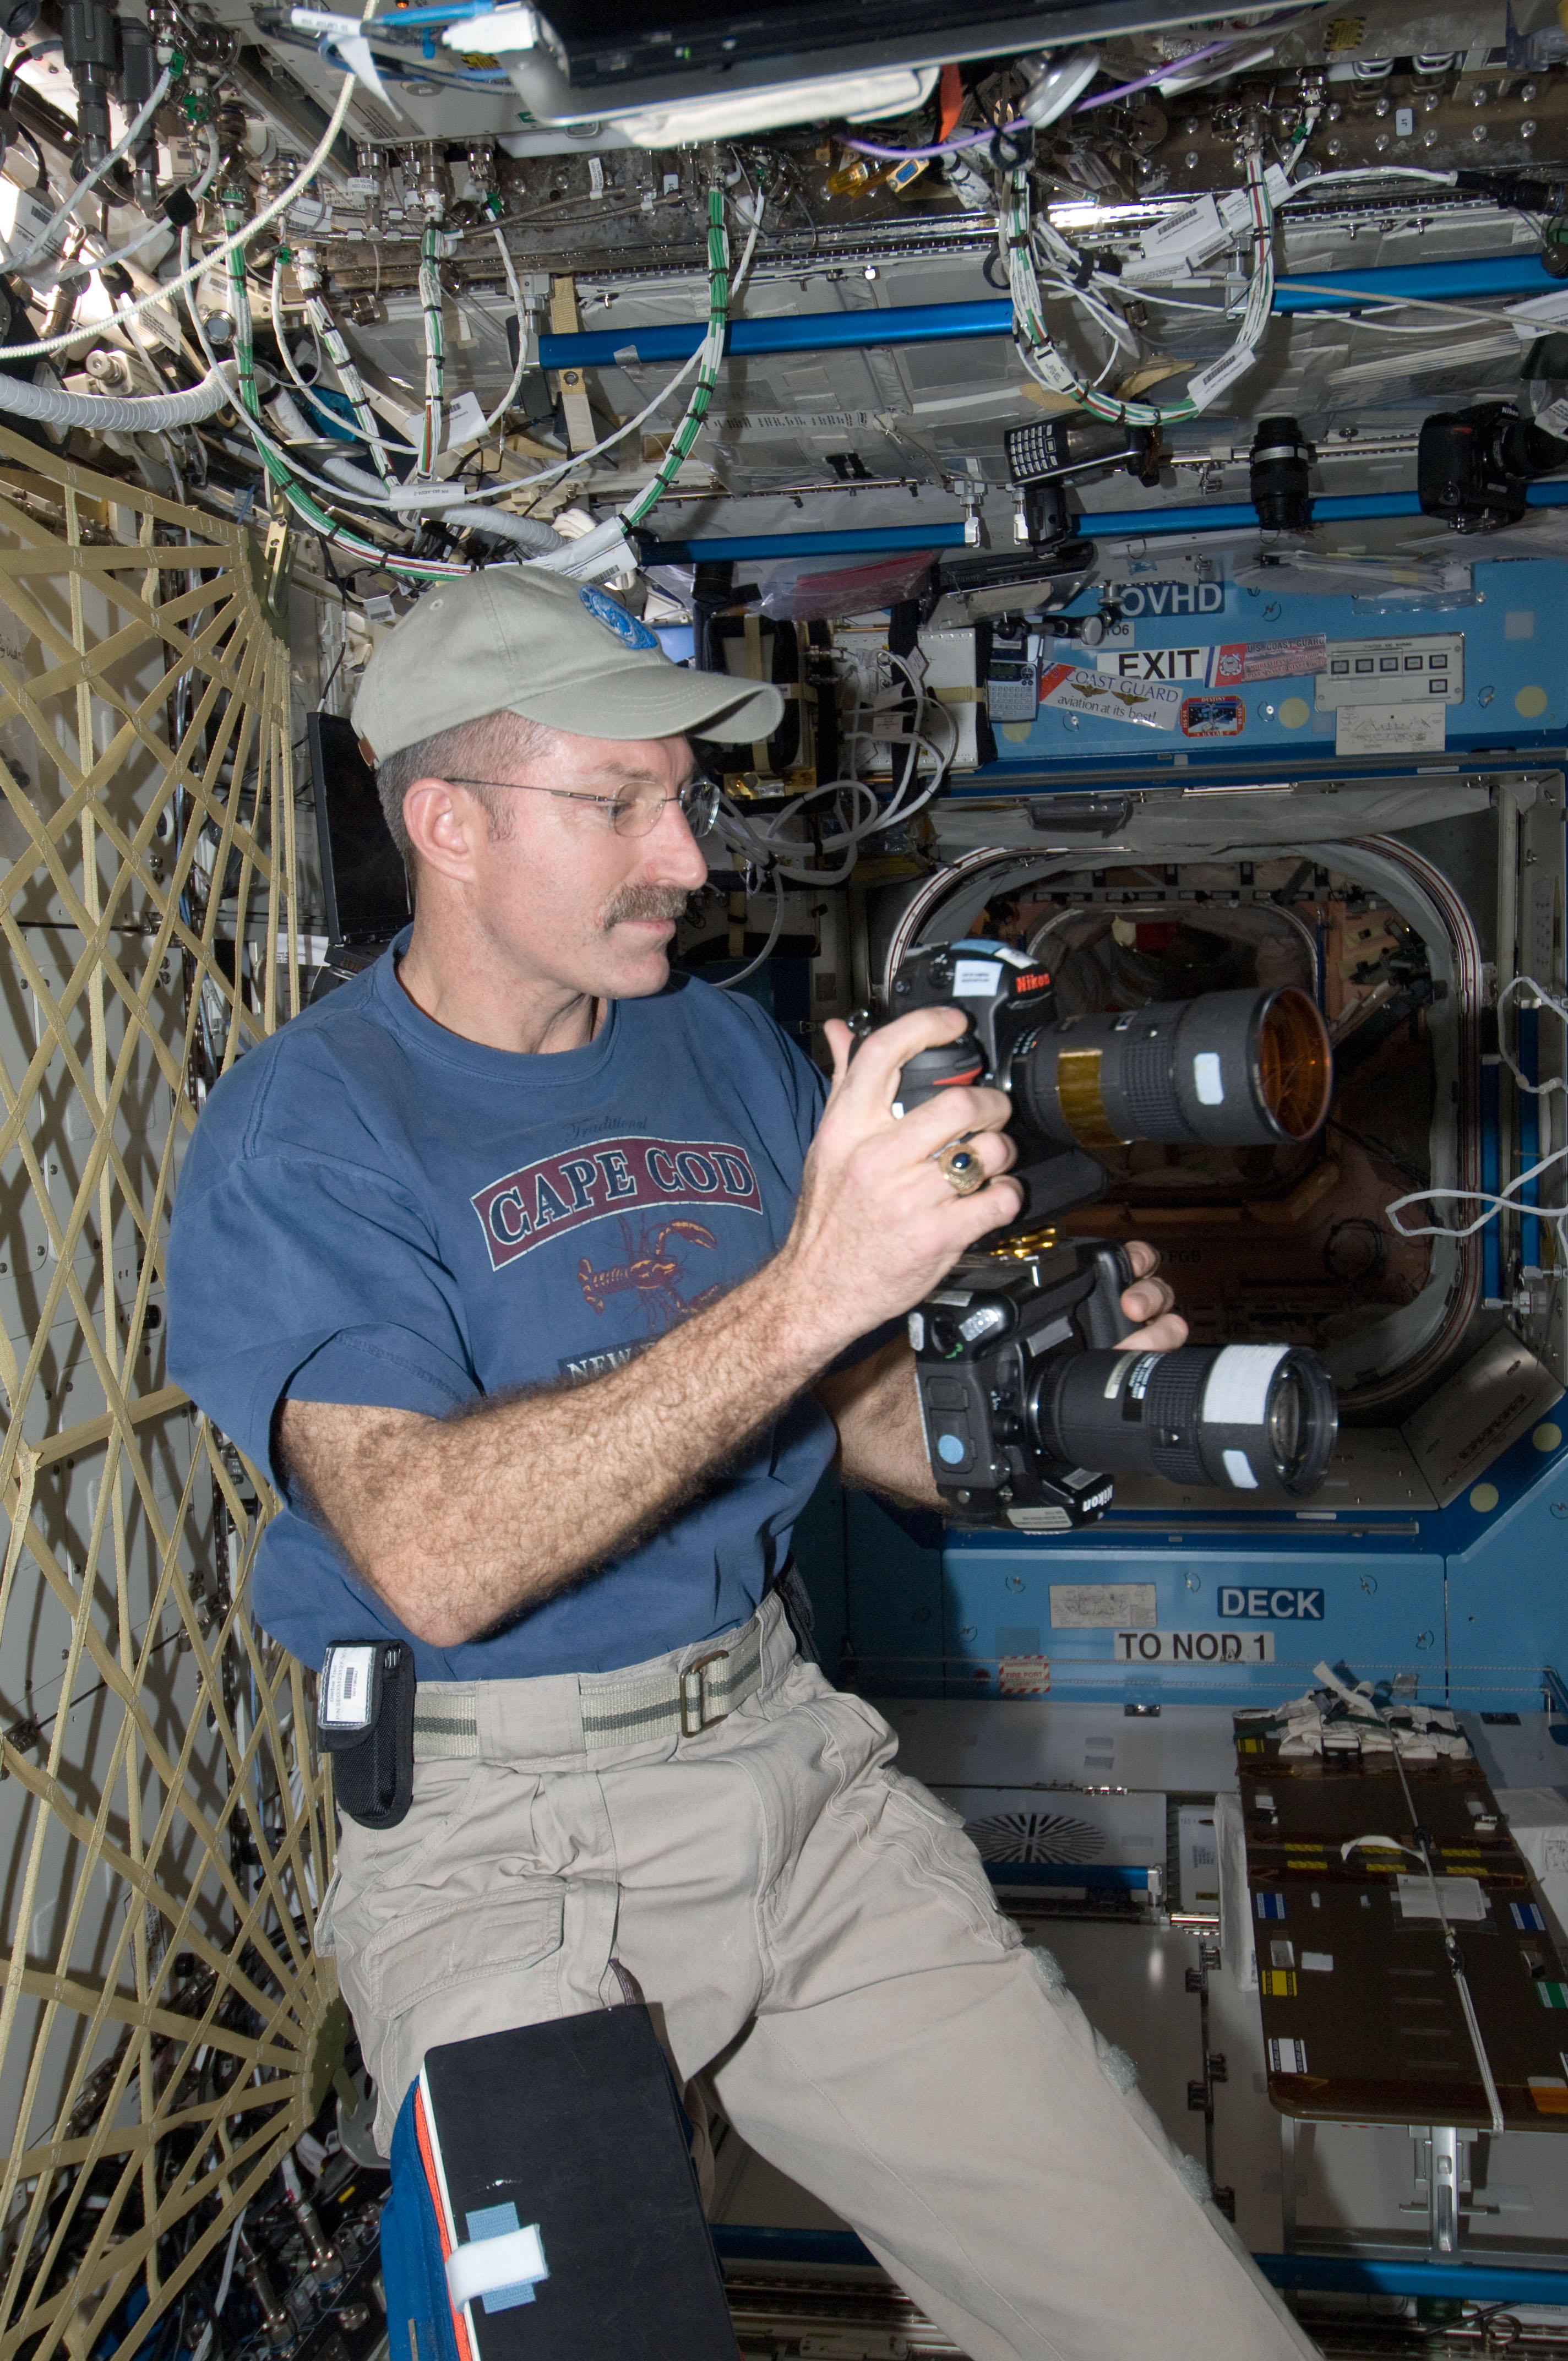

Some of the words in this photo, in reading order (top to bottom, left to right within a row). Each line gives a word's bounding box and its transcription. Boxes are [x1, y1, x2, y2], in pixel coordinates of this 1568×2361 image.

[1401, 118, 1408, 127] J1
[1120, 583, 1223, 615] OVHD
[1267, 641, 1294, 651] COAST
[1297, 637, 1325, 647] GUARD
[1118, 650, 1201, 682] EXIT
[1065, 669, 1116, 689] COAST
[1120, 681, 1178, 703] GUARD
[1058, 695, 1098, 712] aviation
[1101, 705, 1110, 714] at
[1113, 705, 1125, 716] its
[1129, 708, 1156, 723] best!
[1015, 972, 1052, 993] Nikon
[564, 1116, 649, 1141] Traditional
[488, 1149, 637, 1245] CAPE
[645, 1146, 755, 1197] COD
[1082, 1484, 1114, 1512] Nikon
[1222, 1589, 1321, 1619] DECK
[1119, 1633, 1162, 1660] TO
[1173, 1633, 1242, 1660] NOD
[1254, 1634, 1265, 1660] 1
